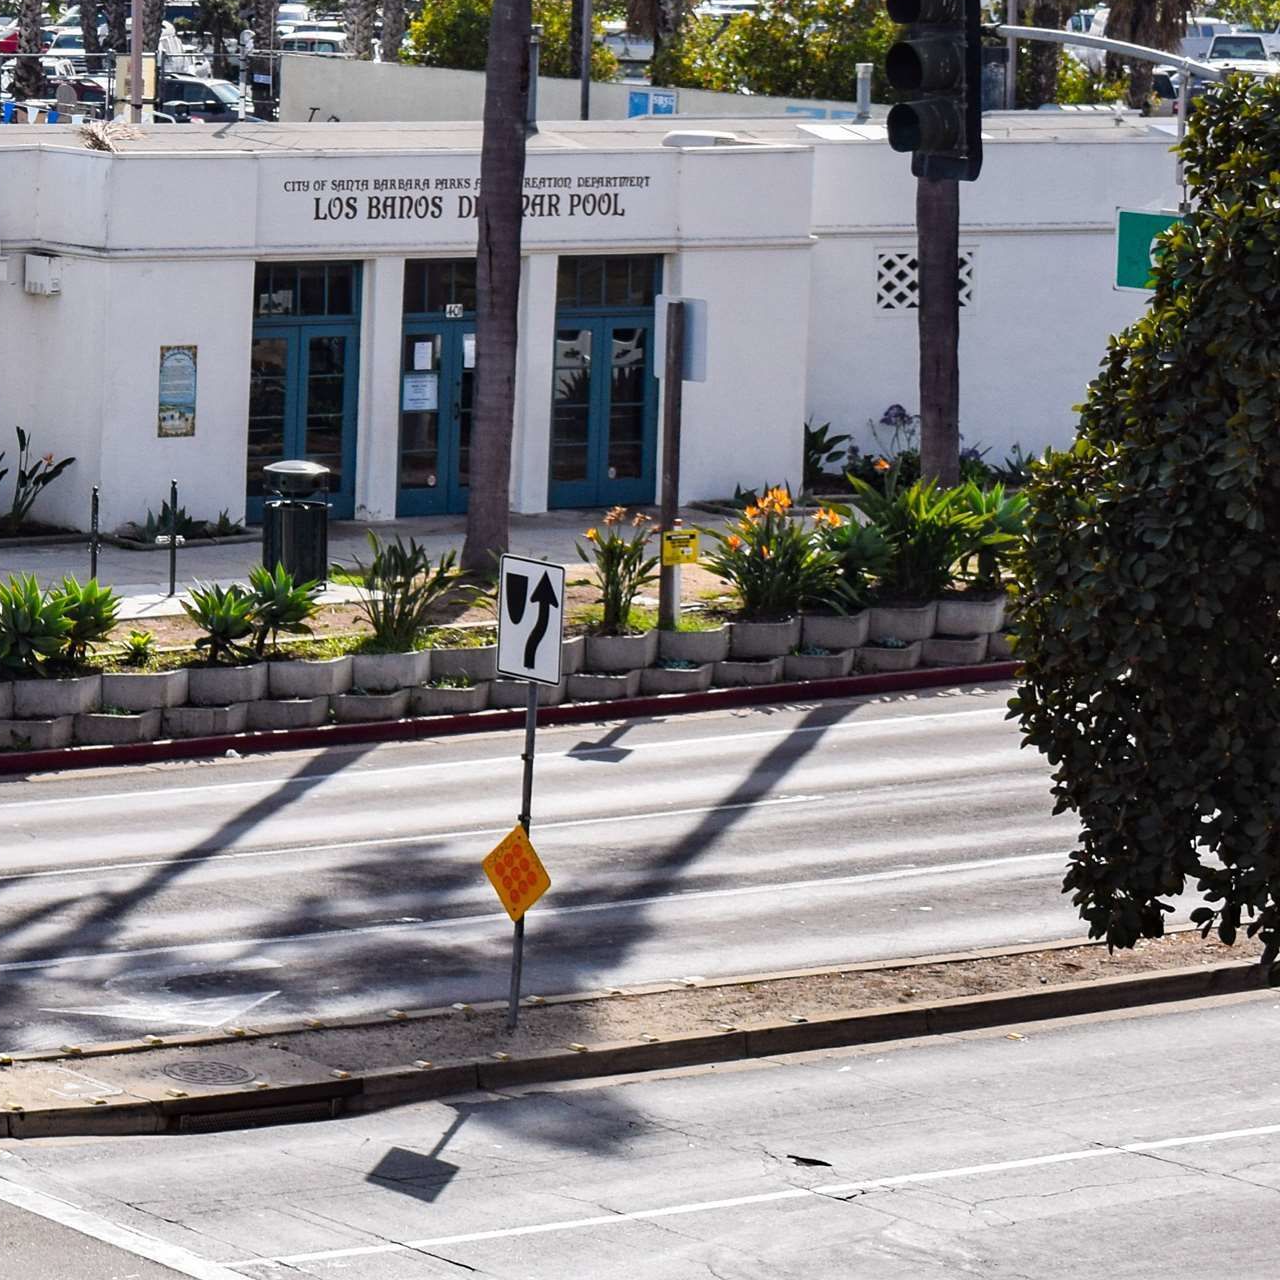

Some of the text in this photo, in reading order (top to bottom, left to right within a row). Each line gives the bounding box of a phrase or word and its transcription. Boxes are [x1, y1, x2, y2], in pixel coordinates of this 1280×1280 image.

[284, 180, 309, 192] CITY
[313, 180, 328, 191] OF
[331, 179, 369, 191] SANTA
[373, 178, 430, 191] BARBARA
[434, 178, 471, 190] PARKS
[524, 177, 572, 189] REATION
[577, 175, 651, 189] DEPARTMENT
[313, 196, 358, 221] LOS
[367, 195, 444, 220] BANOS
[568, 192, 625, 217] POOL
